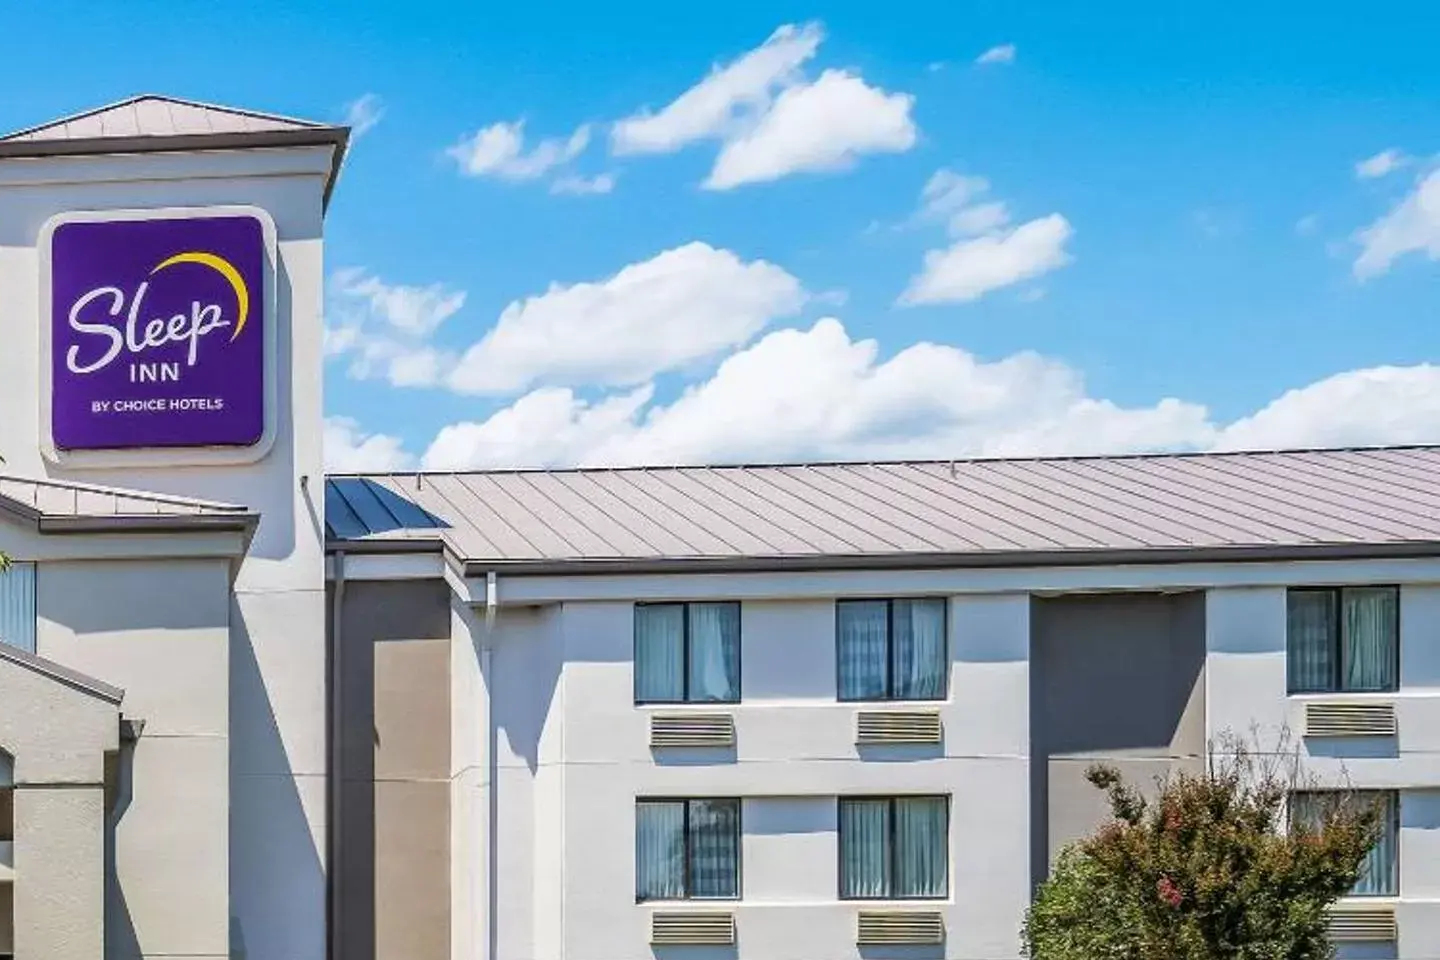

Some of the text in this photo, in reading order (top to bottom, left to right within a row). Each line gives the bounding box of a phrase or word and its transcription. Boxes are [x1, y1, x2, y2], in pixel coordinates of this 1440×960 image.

[66, 281, 231, 374] Sleep
[130, 362, 179, 383] INN
[91, 398, 224, 412] BY CHOICE HOTELS
